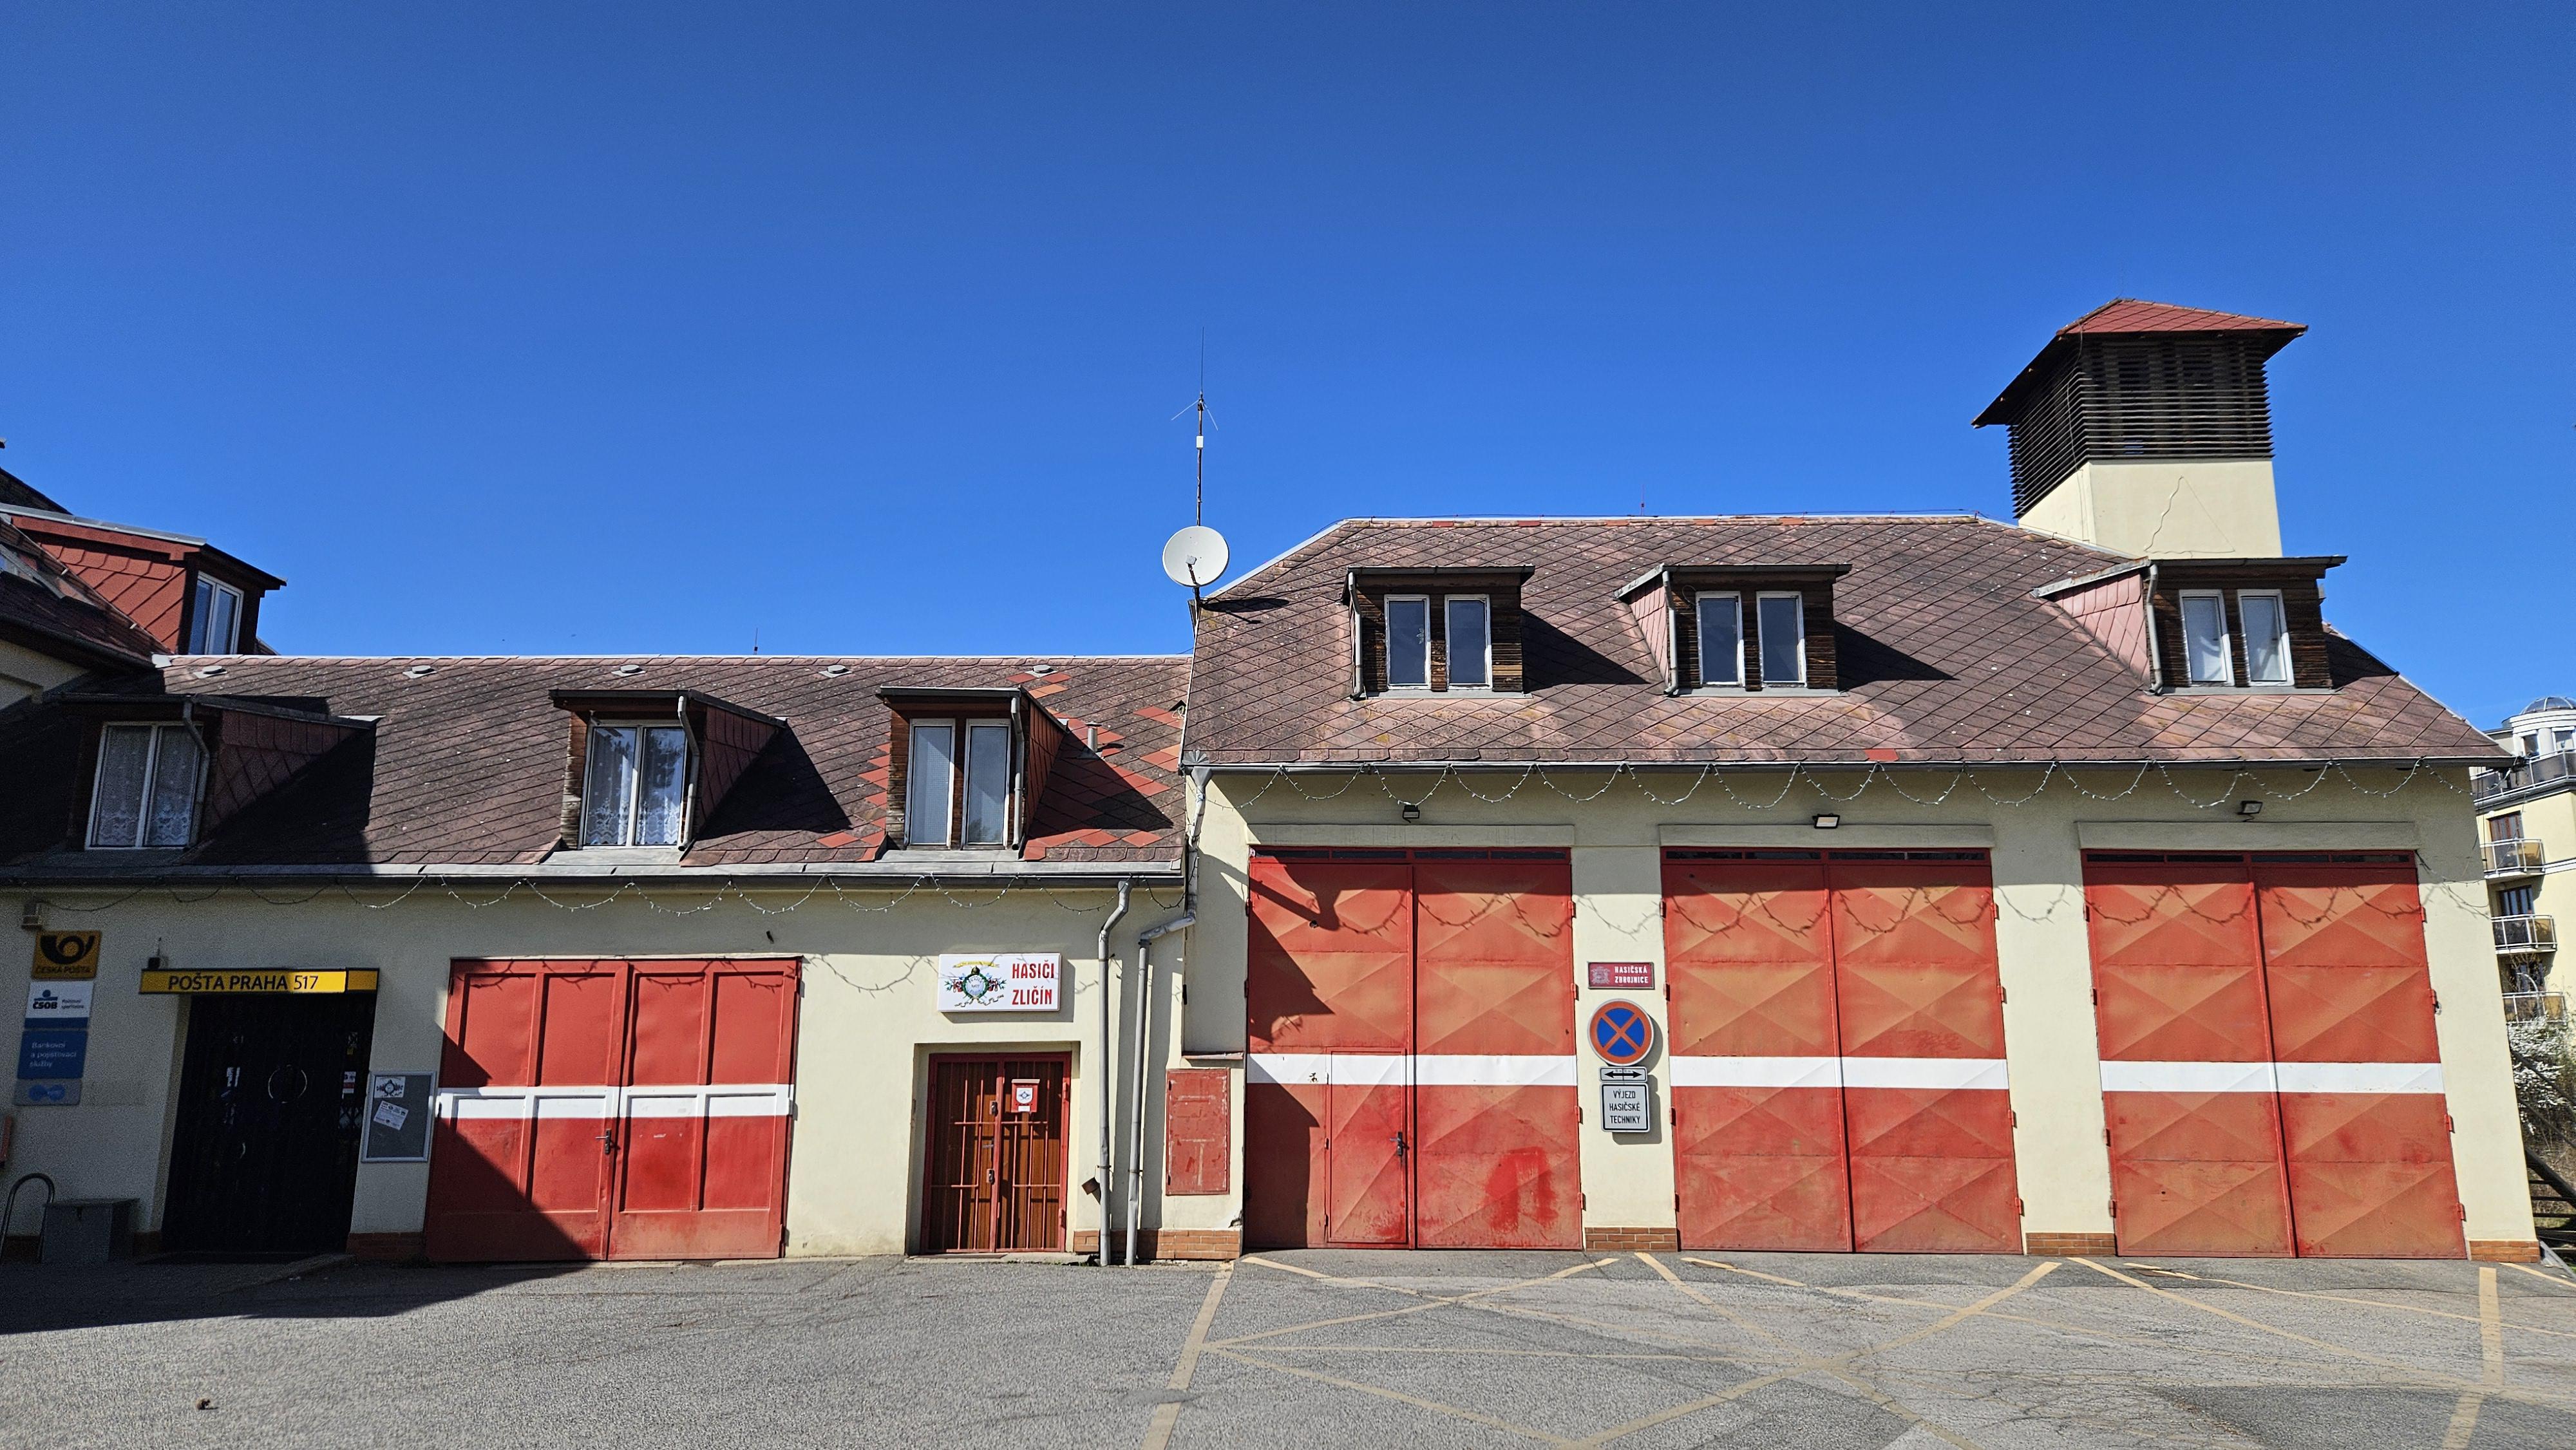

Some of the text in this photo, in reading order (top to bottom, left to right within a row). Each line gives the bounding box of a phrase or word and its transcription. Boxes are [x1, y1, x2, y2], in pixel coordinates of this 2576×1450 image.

[1012, 959, 1054, 979] HASIČI
[1614, 965, 1648, 974] HASIČSKÁ
[168, 972, 319, 990] POŠTA PRAHA 517
[1012, 986, 1052, 1005] ZLIČÍN
[1613, 1089, 1636, 1098] VÝJEZD
[1609, 1102, 1641, 1111] HASIČSKÉ
[1610, 1115, 1640, 1124] TECHNIKY
